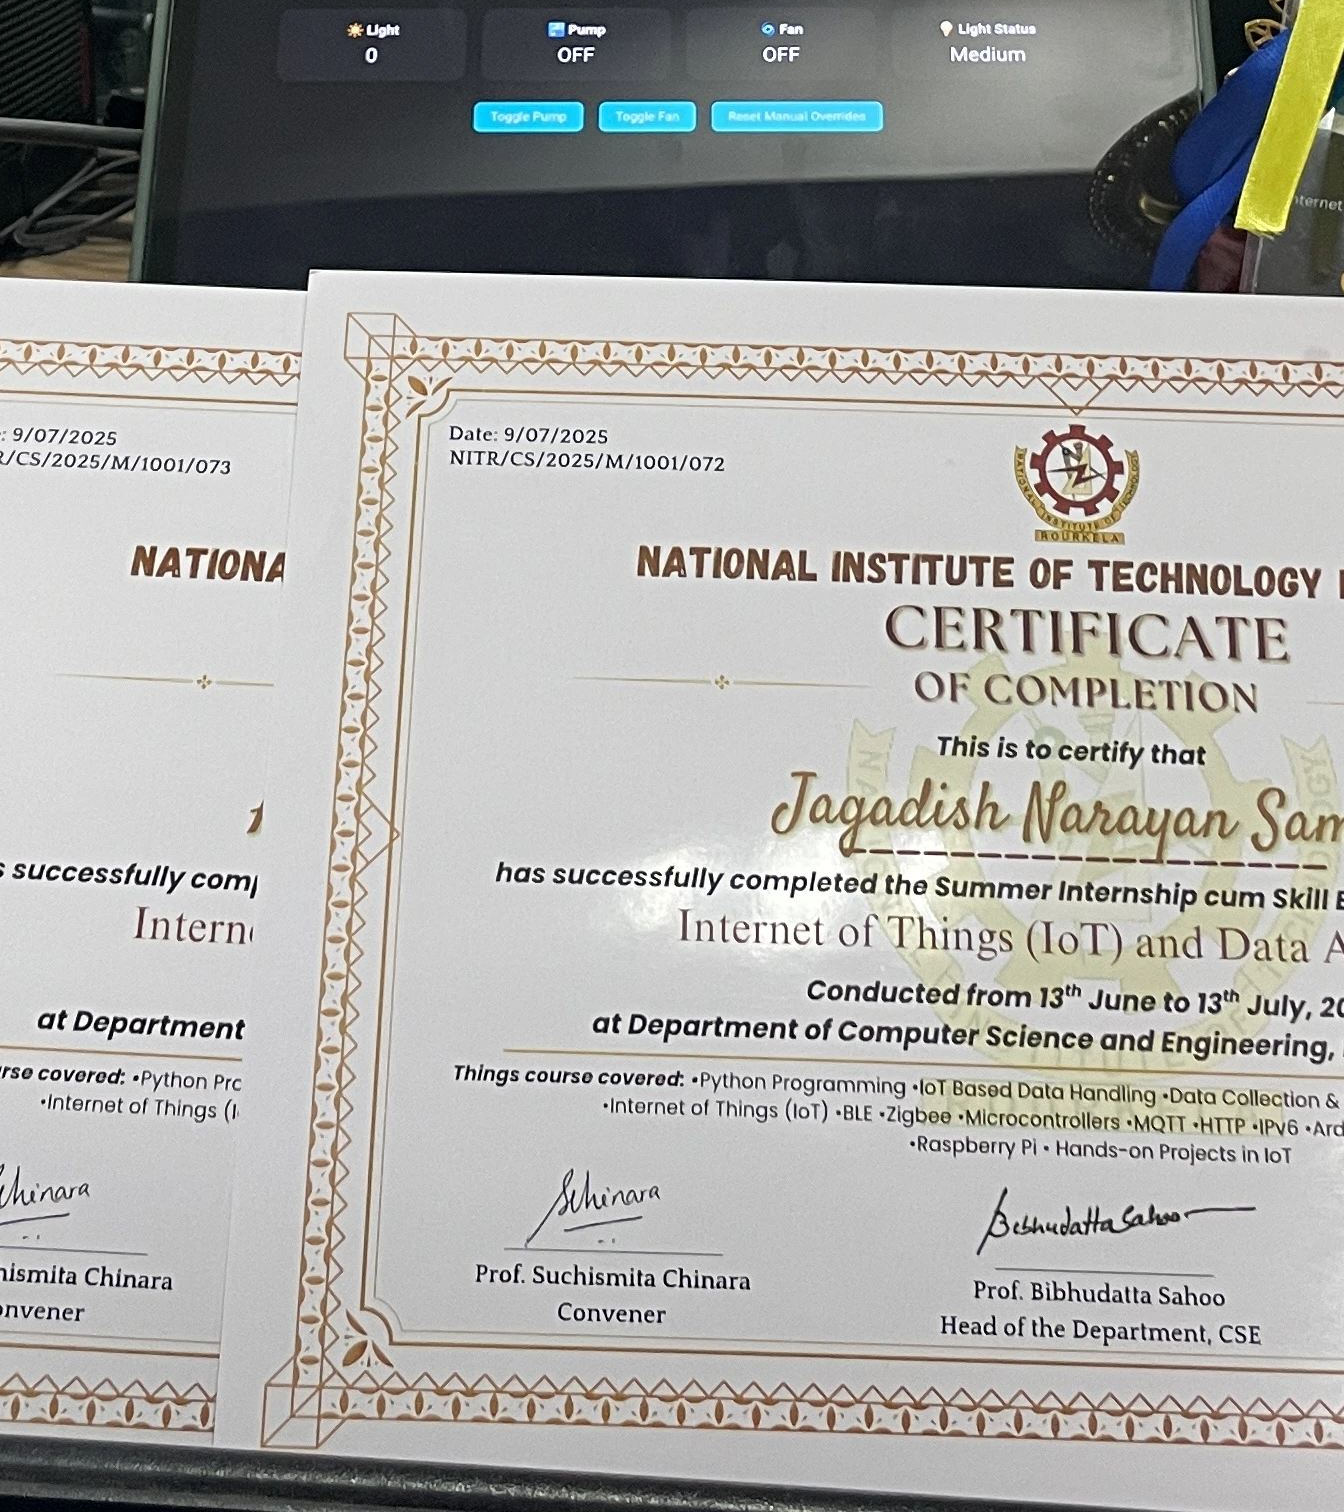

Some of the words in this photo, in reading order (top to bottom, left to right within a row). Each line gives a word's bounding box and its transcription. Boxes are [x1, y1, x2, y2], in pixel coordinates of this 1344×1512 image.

[366, 23, 400, 39] Light
[568, 23, 607, 39] Pump
[779, 22, 804, 36] Fan
[958, 22, 991, 38] Light
[994, 22, 1037, 37] Status
[557, 46, 595, 63] OFF
[762, 46, 800, 63] OFF
[949, 46, 1026, 63] Medium
[491, 110, 531, 126] Toggle
[533, 110, 567, 125] Pump
[616, 109, 655, 125] Toggle
[656, 109, 680, 123] Fan
[728, 109, 760, 122] Reset
[763, 109, 807, 122] Manual
[810, 109, 866, 122] Overrides
[12, 427, 118, 446] 9/07/2025
[449, 426, 498, 444] Date:
[504, 426, 609, 445] 9/07/2025
[449, 449, 726, 473] NITR/CS/2025/M/1001/072
[637, 545, 817, 582] NATIONAL
[831, 550, 1014, 588] INSTITUTE
[1029, 557, 1074, 589] OF
[1088, 559, 1322, 599] TECHNOLOGY
[885, 605, 1291, 664] CERTIFICATE
[914, 670, 970, 704] OF
[984, 672, 1258, 713] COMPLETION
[770, 770, 1011, 857] Jagadish
[1021, 779, 1239, 863] Narayan
[679, 908, 825, 947] Internet
[838, 913, 879, 948] of
[887, 914, 1014, 962] Things
[1026, 918, 1124, 963] (IoT)
[1136, 926, 1204, 961] and
[1218, 926, 1310, 964] Data
[84, 1266, 173, 1292] Chinara
[475, 1264, 526, 1284] Prof.
[532, 1265, 656, 1288] Suchismita
[662, 1269, 751, 1291] Chinara
[973, 1280, 1024, 1301] Prof.
[1030, 1282, 1153, 1306] Bibhudatta
[1158, 1285, 1226, 1307] Sahoo
[557, 1302, 667, 1324] Convener
[940, 1315, 998, 1338] Head
[1003, 1316, 1026, 1338] of
[1031, 1316, 1066, 1338] the
[1072, 1319, 1213, 1346] Department,
[1218, 1324, 1262, 1345] CSE
